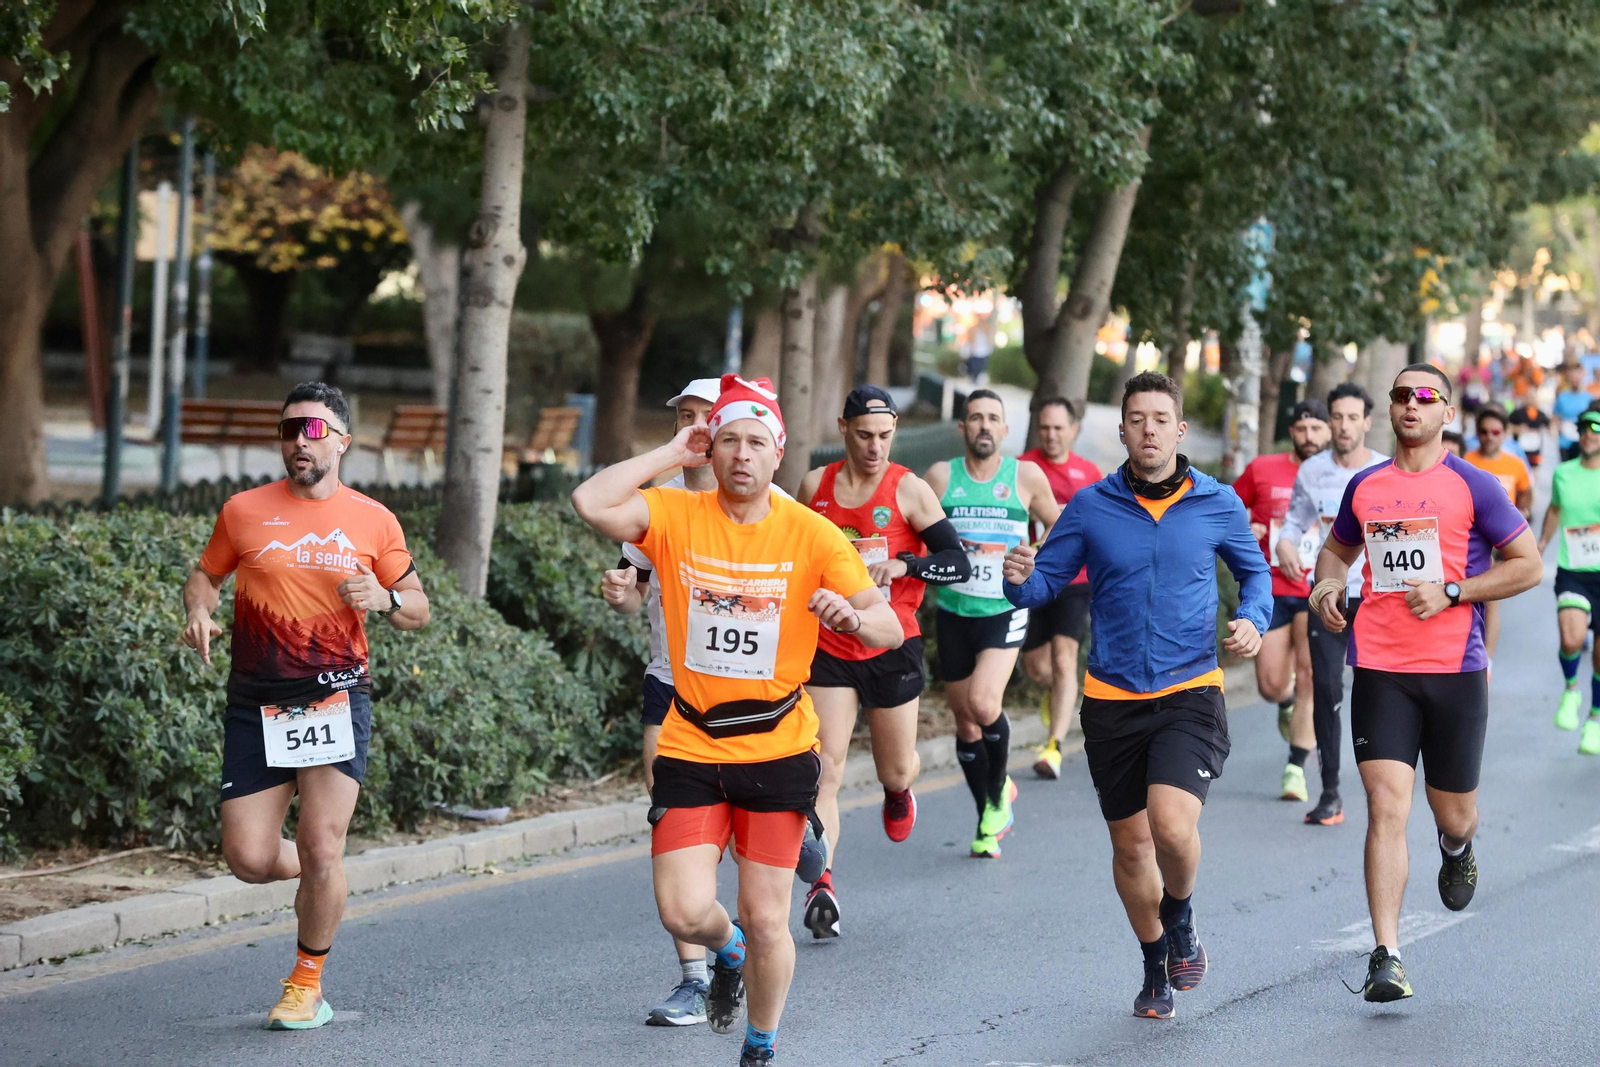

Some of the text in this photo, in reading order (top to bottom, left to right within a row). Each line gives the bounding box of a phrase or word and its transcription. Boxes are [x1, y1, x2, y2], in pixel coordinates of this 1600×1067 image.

[952, 507, 1008, 518] ATLETISMO
[296, 546, 358, 570] la senda
[779, 561, 793, 572] XII
[1383, 549, 1425, 572] 440
[929, 564, 937, 572] C
[946, 565, 956, 573] M
[742, 578, 787, 587] CARRERA
[706, 626, 758, 655] 195
[286, 724, 335, 751] 541
